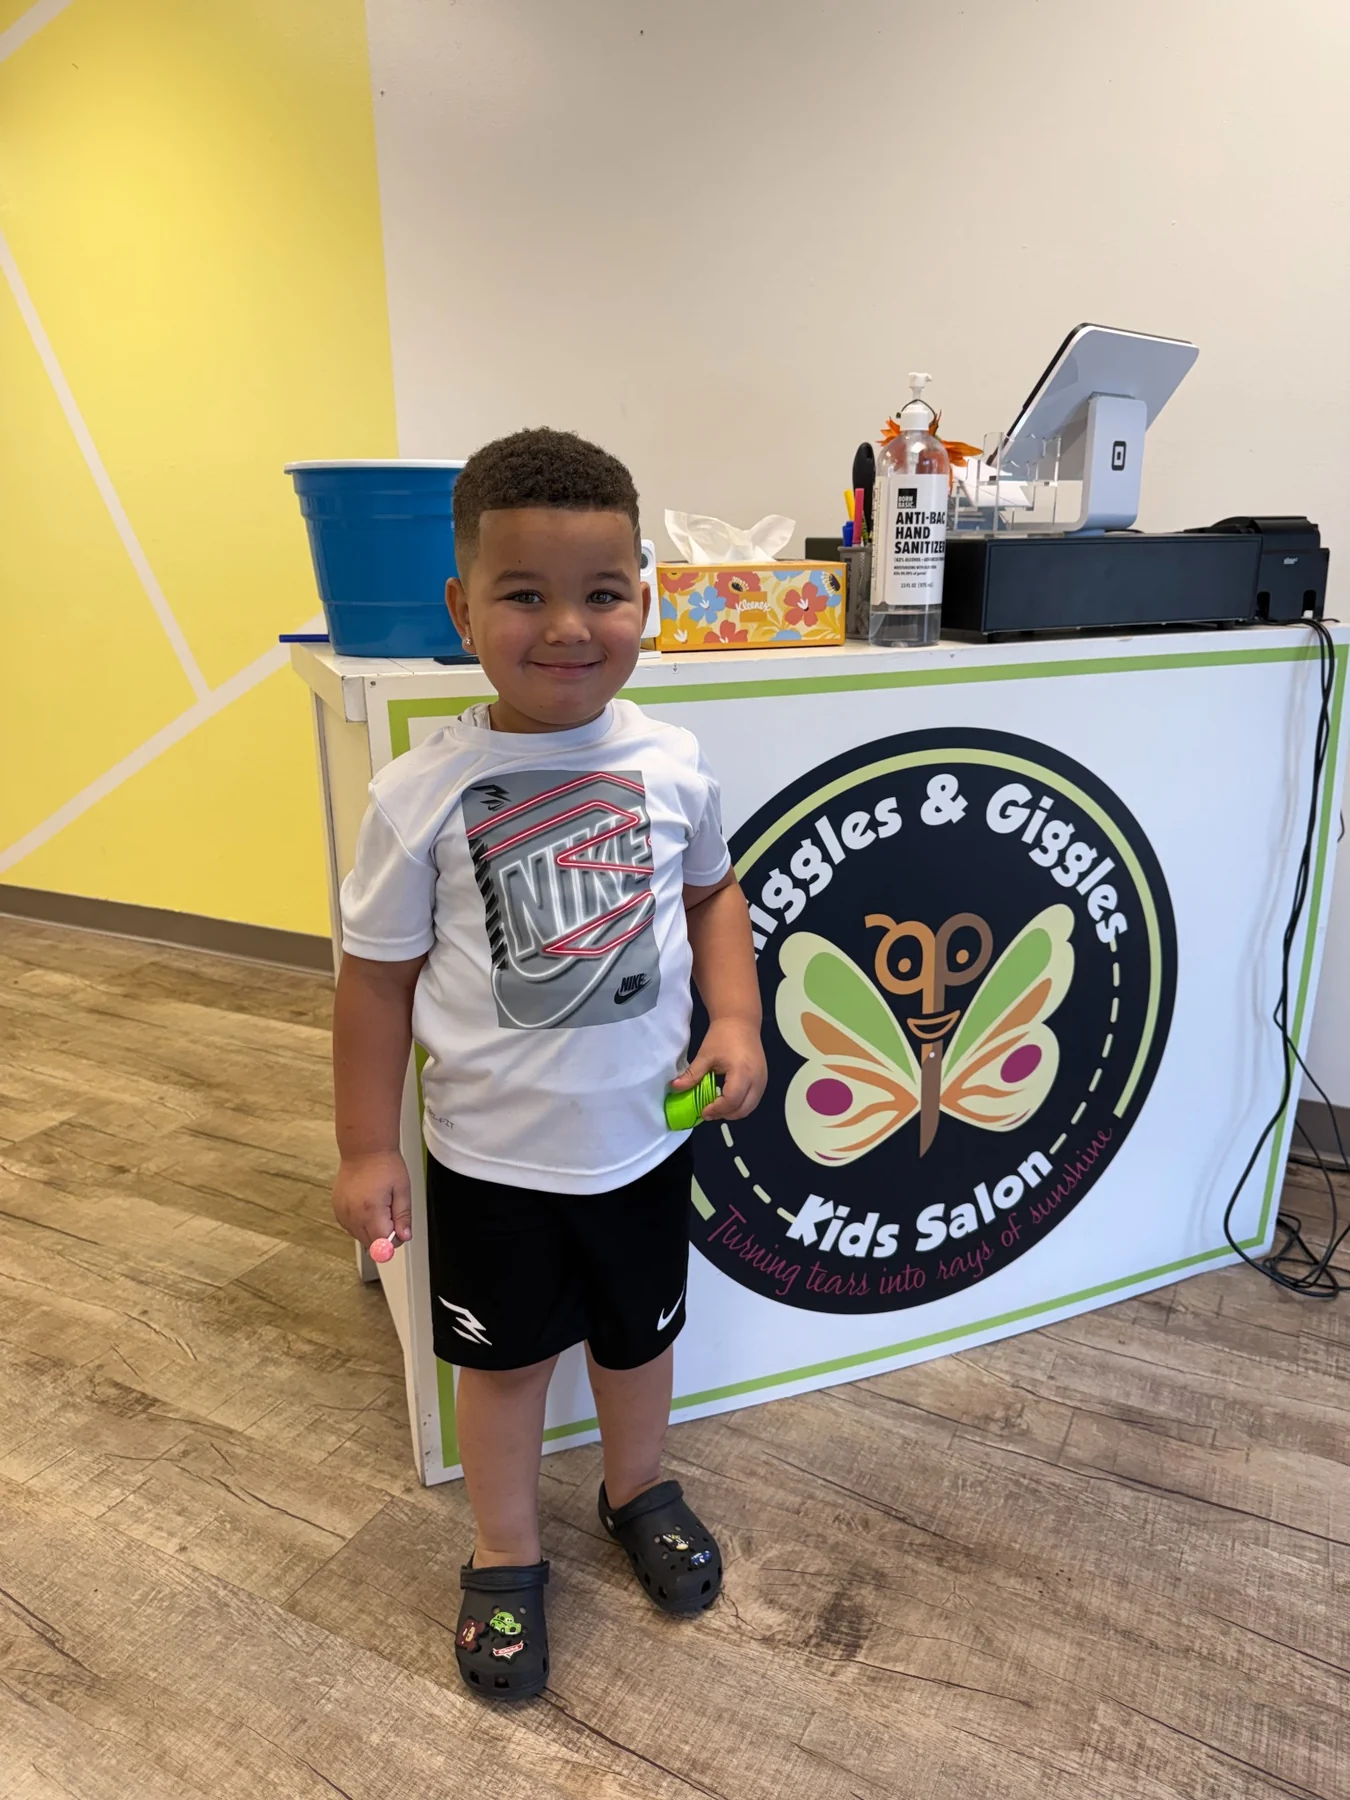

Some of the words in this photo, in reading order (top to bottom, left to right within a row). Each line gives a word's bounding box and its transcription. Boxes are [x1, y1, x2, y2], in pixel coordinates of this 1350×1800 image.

[895, 511, 945, 524] ANTI-BAC
[895, 526, 931, 540] HAND
[735, 599, 771, 612] Kleenex
[499, 805, 653, 958] NIKE
[746, 796, 903, 961] iggles
[920, 773, 968, 826] &
[985, 782, 1128, 944] Giggles
[620, 973, 645, 992] NIKE
[707, 1204, 801, 1296] Turning
[805, 1261, 871, 1296] tears
[879, 1263, 926, 1295] into
[936, 1240, 994, 1278] rays
[1001, 1212, 1022, 1247] of
[1029, 1127, 1113, 1224] sunshine
[785, 1193, 900, 1259] Kids
[915, 1150, 1053, 1252] Salon
